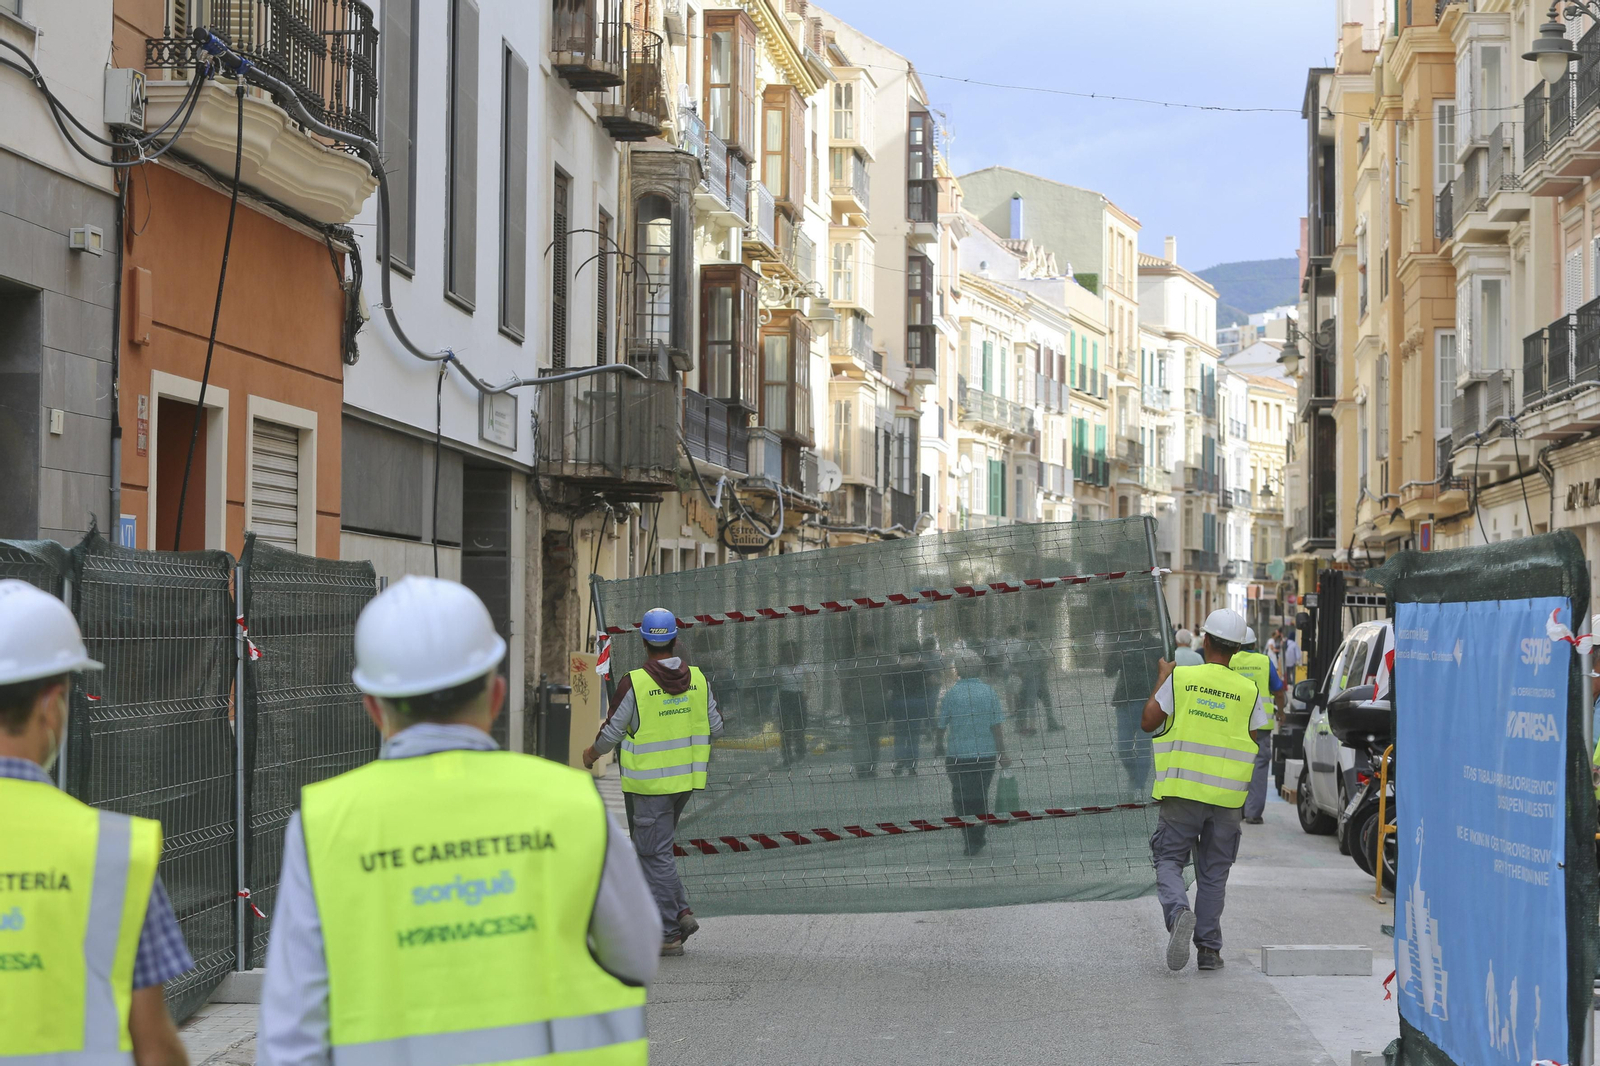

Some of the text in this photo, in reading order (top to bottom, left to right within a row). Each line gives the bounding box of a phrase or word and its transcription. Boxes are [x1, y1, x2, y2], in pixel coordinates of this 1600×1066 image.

[1199, 687, 1240, 701] CARRETERÍA
[361, 827, 557, 873] UTE CARRETERÍA
